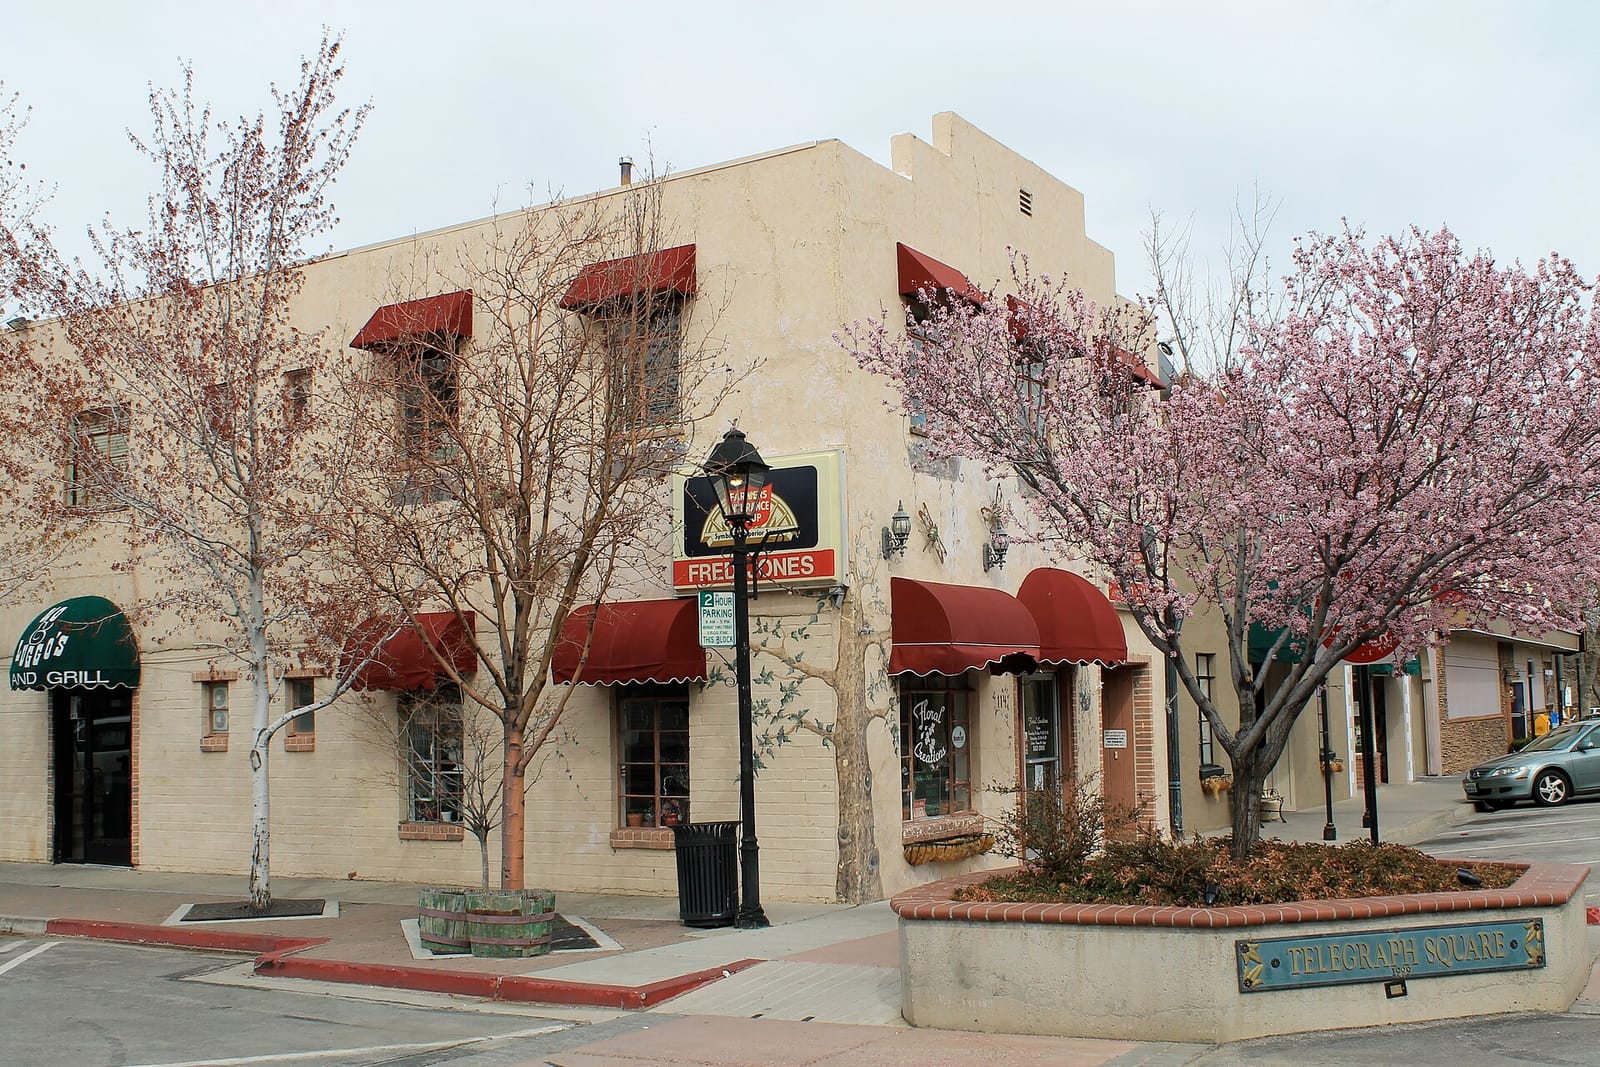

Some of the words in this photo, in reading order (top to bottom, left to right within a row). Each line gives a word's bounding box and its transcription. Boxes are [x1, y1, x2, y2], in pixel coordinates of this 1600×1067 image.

[704, 593, 713, 606] 2
[715, 596, 733, 606] HOUR
[703, 608, 733, 618] PARKING
[703, 635, 714, 645] THIS
[715, 635, 733, 645] BLOCK
[12, 671, 38, 686] AND
[46, 670, 110, 685] GRILL
[996, 694, 1008, 709] 114
[913, 698, 946, 731] Floral
[913, 740, 947, 764] Creations
[1287, 937, 1419, 976] TELEGRAPH
[1424, 931, 1506, 968] SQUARE
